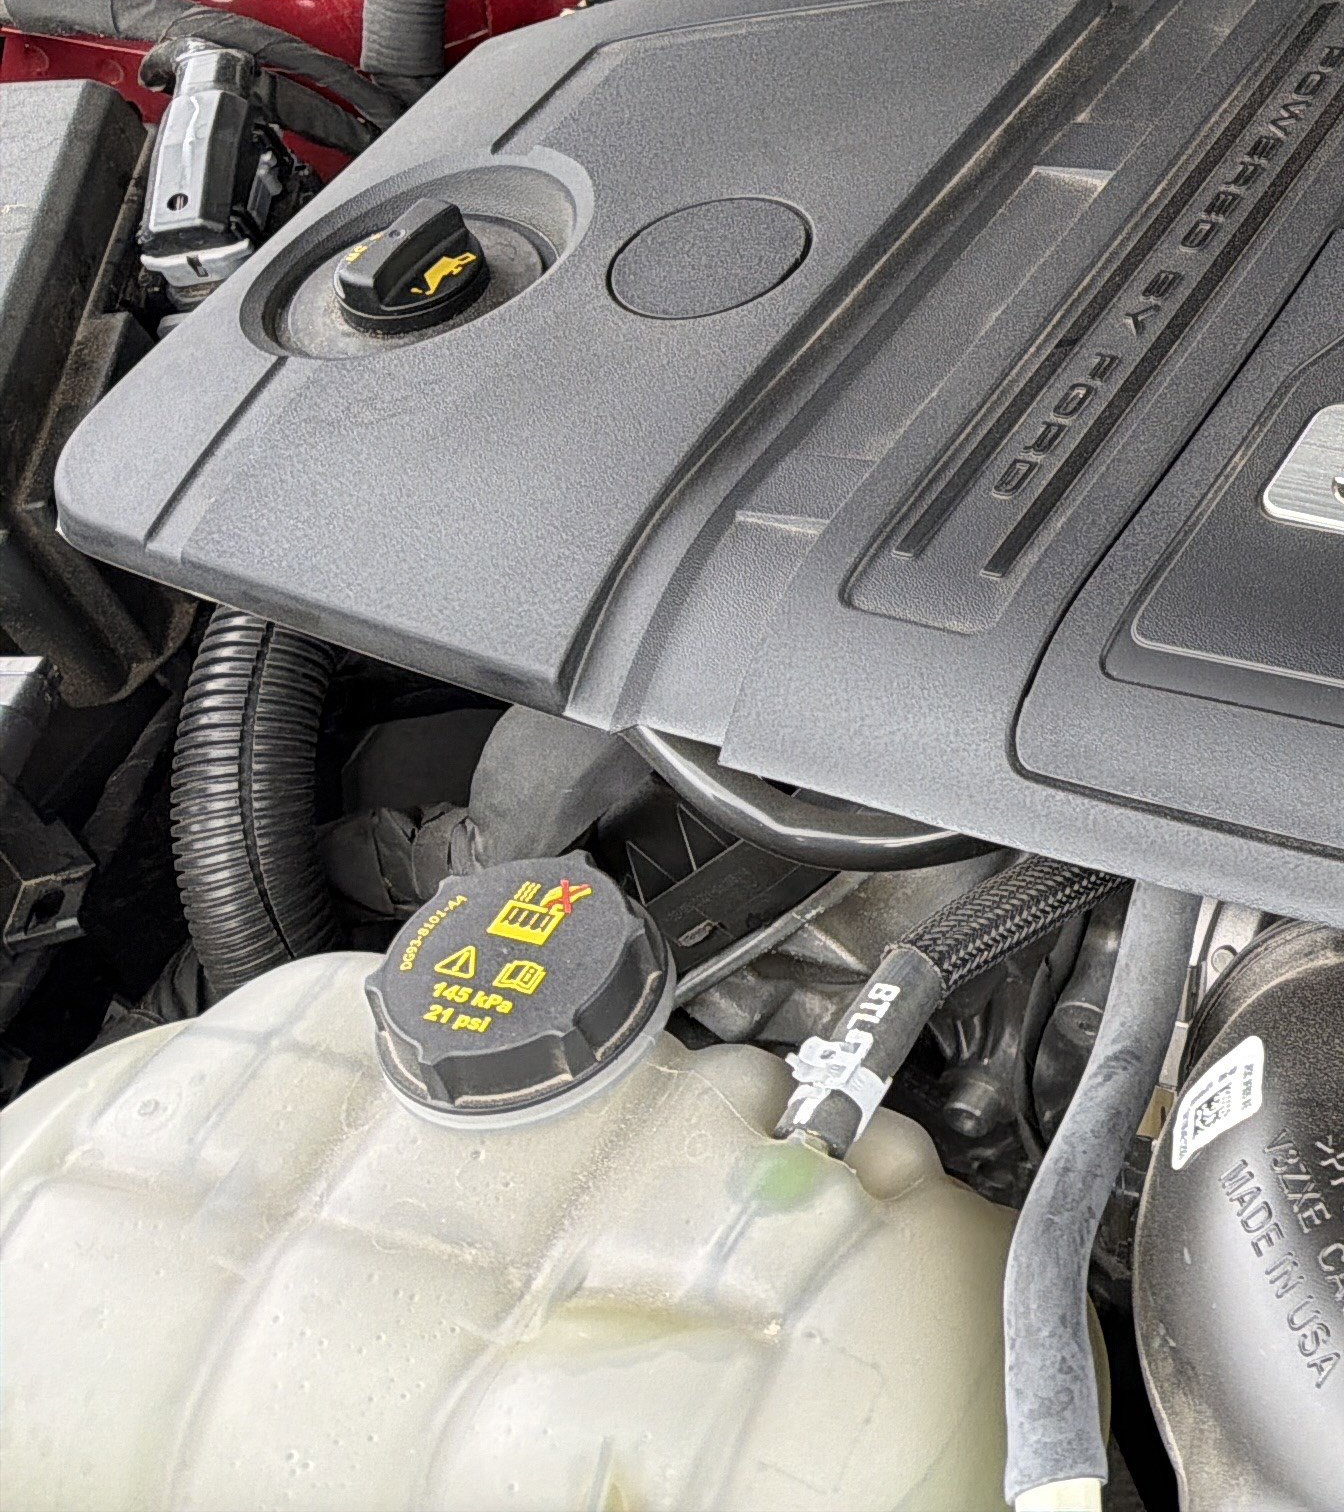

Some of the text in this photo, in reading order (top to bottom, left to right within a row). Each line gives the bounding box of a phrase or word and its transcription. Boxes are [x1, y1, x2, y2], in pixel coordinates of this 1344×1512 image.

[1125, 268, 1184, 333] BY
[993, 352, 1121, 498] FORD
[423, 1004, 492, 1033] 21 psi
[433, 981, 514, 1014] 145 kPa
[1218, 1159, 1341, 1388] MADE IN USA
